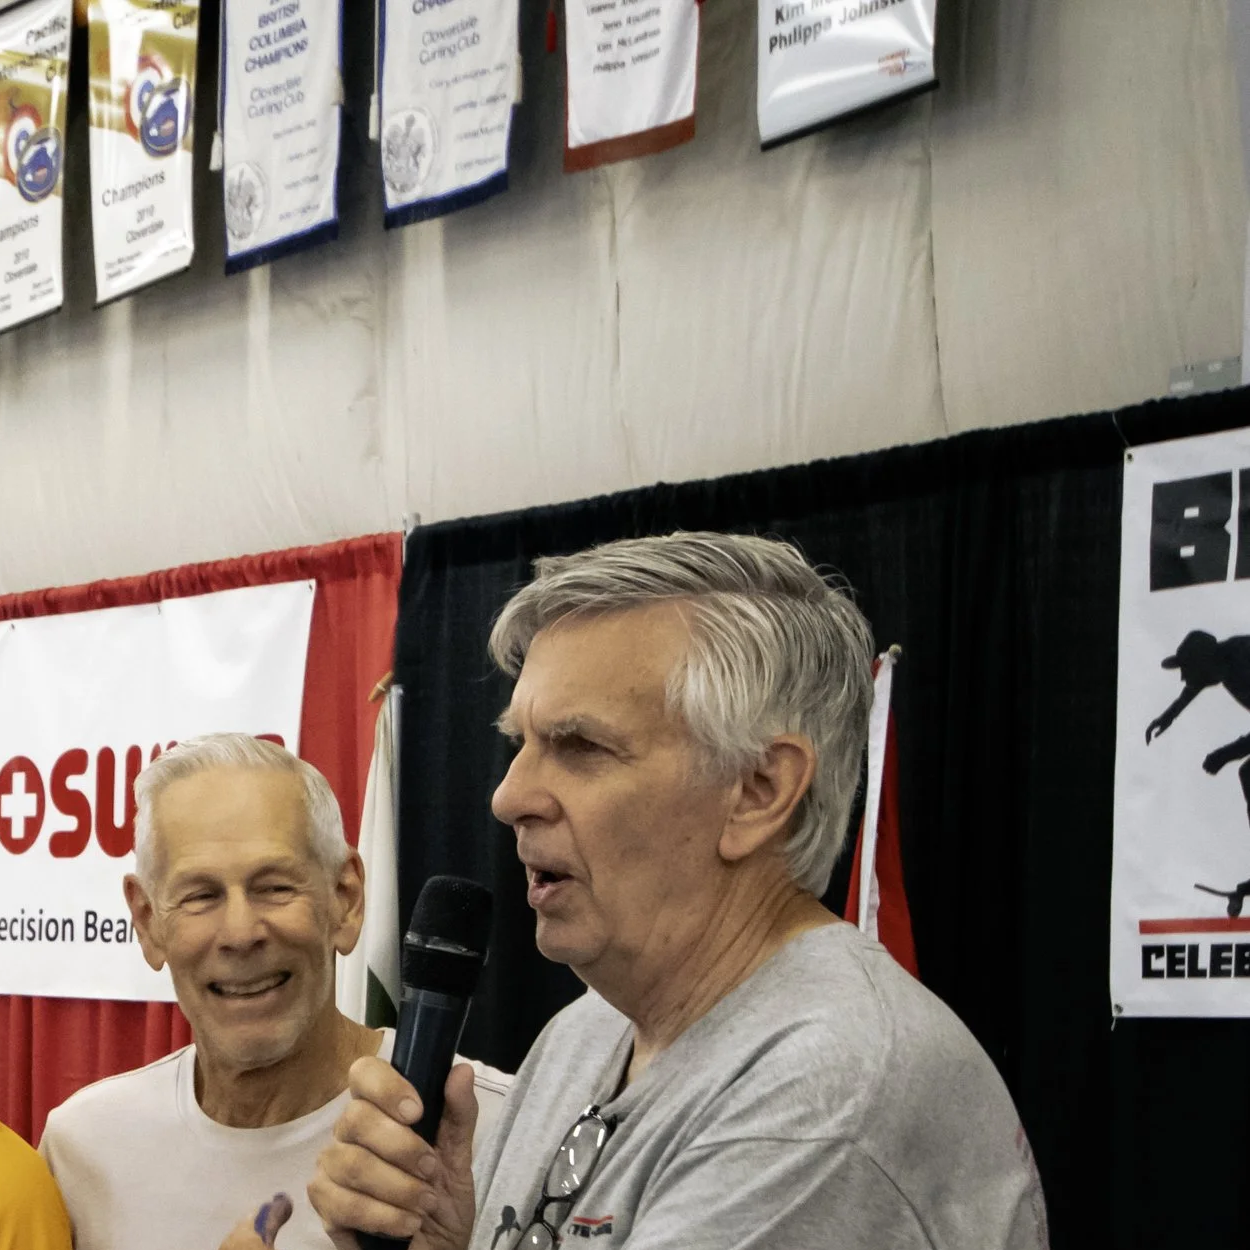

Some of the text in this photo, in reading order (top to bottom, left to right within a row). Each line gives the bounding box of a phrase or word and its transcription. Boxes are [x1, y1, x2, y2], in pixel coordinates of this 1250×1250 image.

[422, 15, 478, 47] Cloverdale
[775, 3, 806, 25] Kim
[248, 18, 308, 51] COLUMBIA
[769, 17, 833, 54] Philippa
[244, 38, 309, 73] CHAMPIONS
[101, 170, 166, 207] Champions
